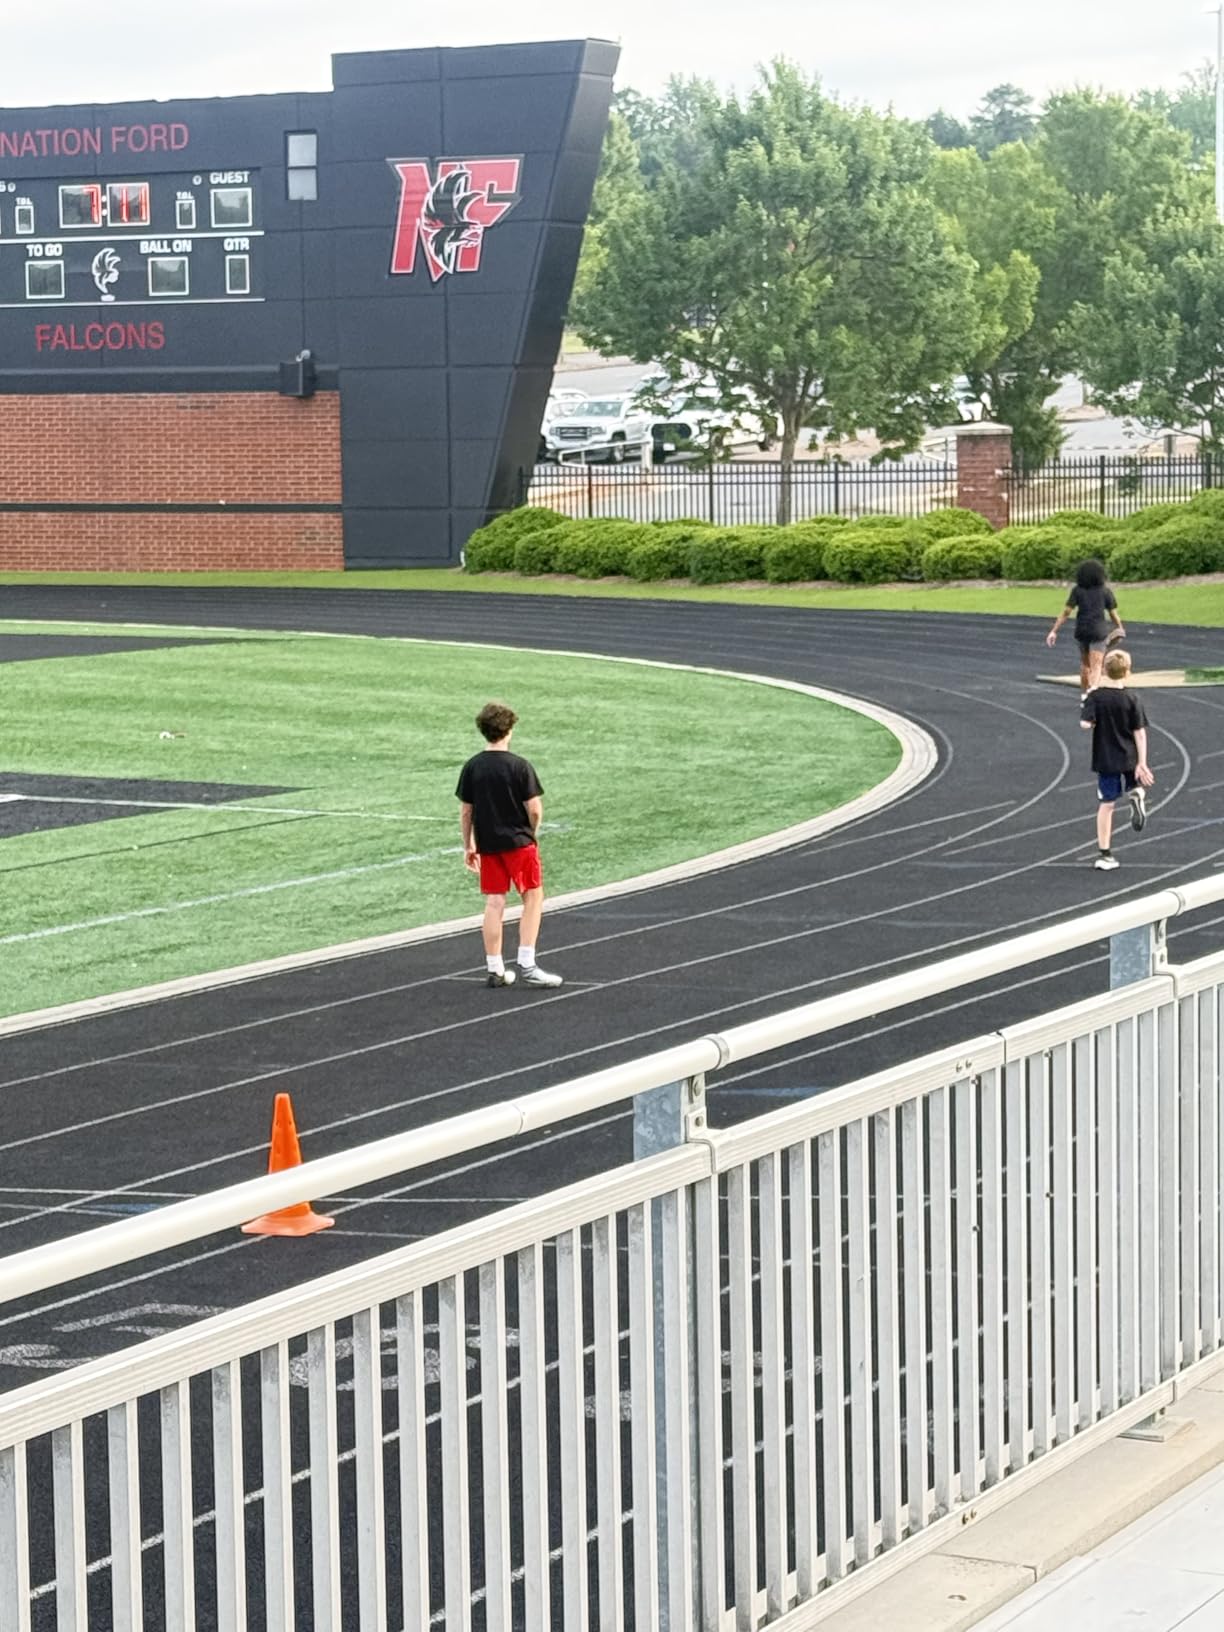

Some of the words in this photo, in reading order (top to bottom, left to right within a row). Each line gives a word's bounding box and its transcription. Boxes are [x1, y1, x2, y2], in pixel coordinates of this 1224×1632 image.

[0, 128, 101, 157] NATION
[111, 123, 189, 152] FORD
[210, 171, 250, 185] GUEST
[26, 245, 45, 257] TO
[45, 243, 63, 256] GO
[140, 241, 171, 254] BALL
[172, 240, 192, 253] ON
[223, 237, 250, 251] QTR
[35, 321, 165, 351] FALCONS
